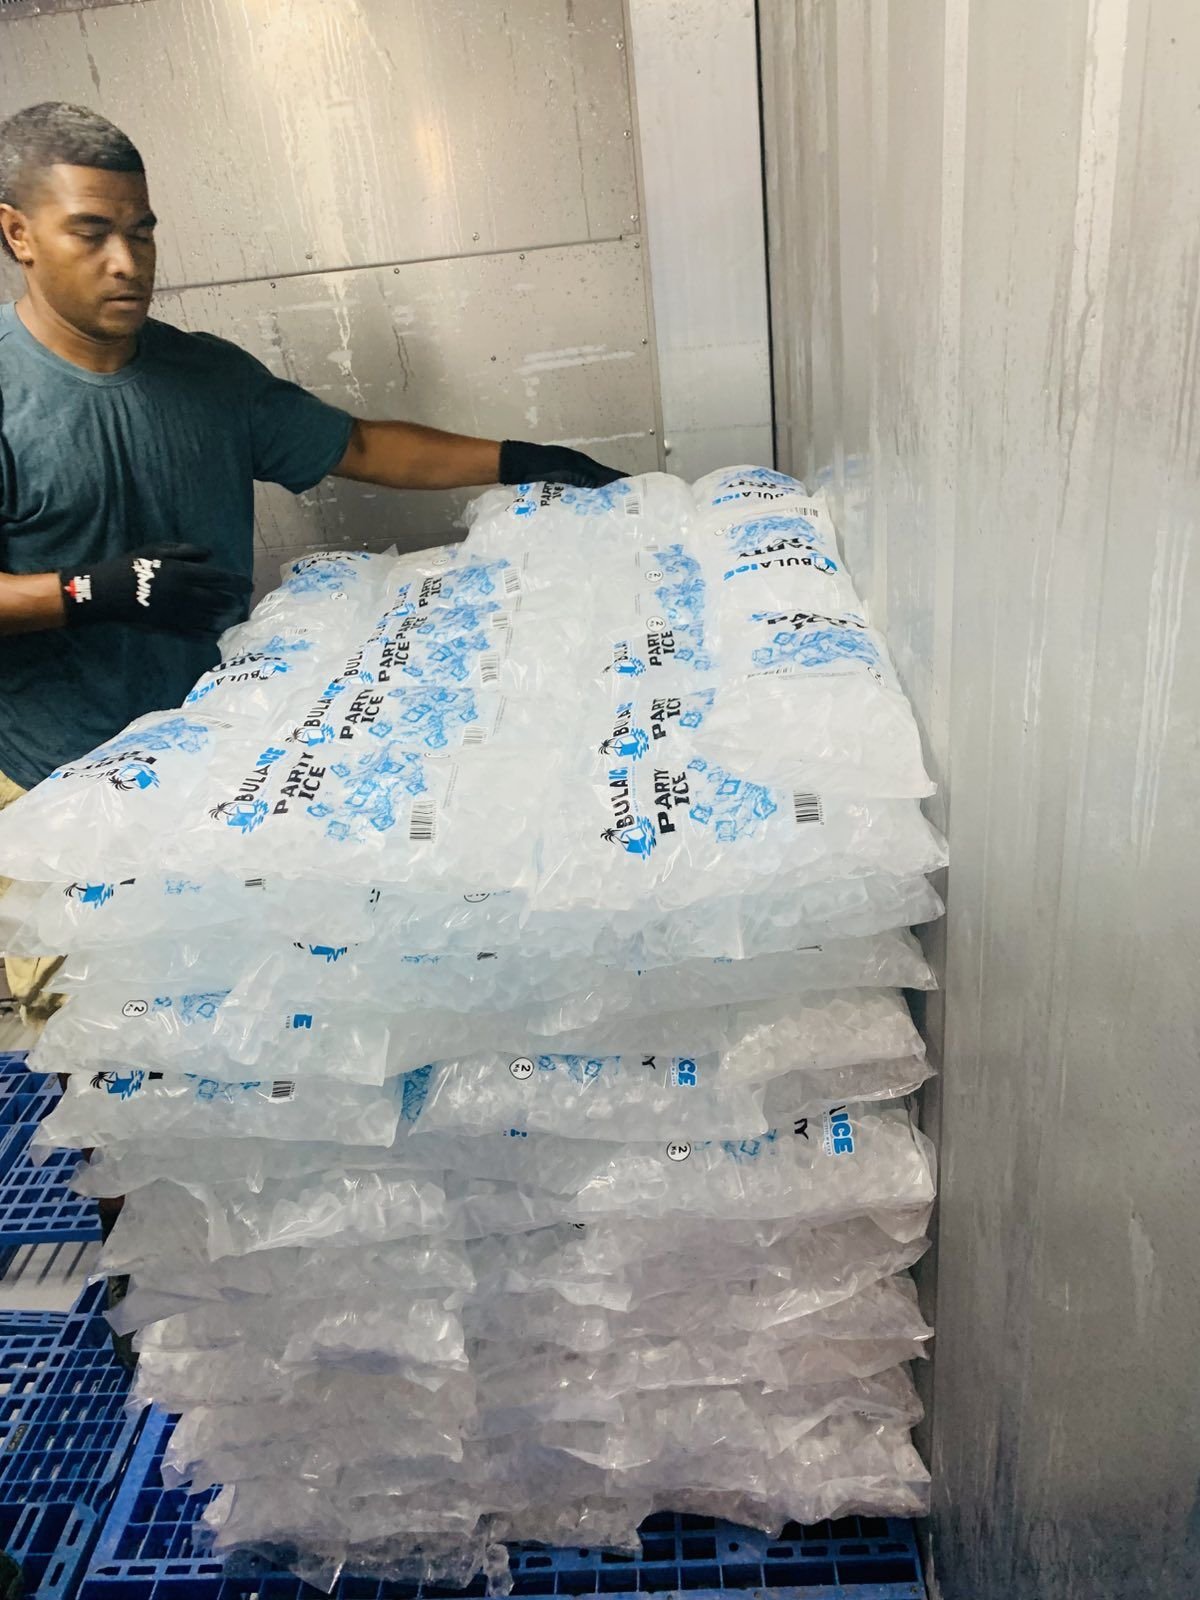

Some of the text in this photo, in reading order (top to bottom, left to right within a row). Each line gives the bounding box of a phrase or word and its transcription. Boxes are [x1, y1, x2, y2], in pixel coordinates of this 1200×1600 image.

[394, 641, 411, 666] ICE
[661, 630, 675, 654] ICE
[360, 695, 384, 724] ICE
[273, 752, 314, 815] PARTY
[298, 766, 326, 801] ICE
[608, 766, 635, 829] BULAIC
[672, 771, 690, 807] ICE
[654, 768, 676, 834] PARTY
[521, 1064, 531, 1072] 2
[679, 1145, 688, 1153] 2
